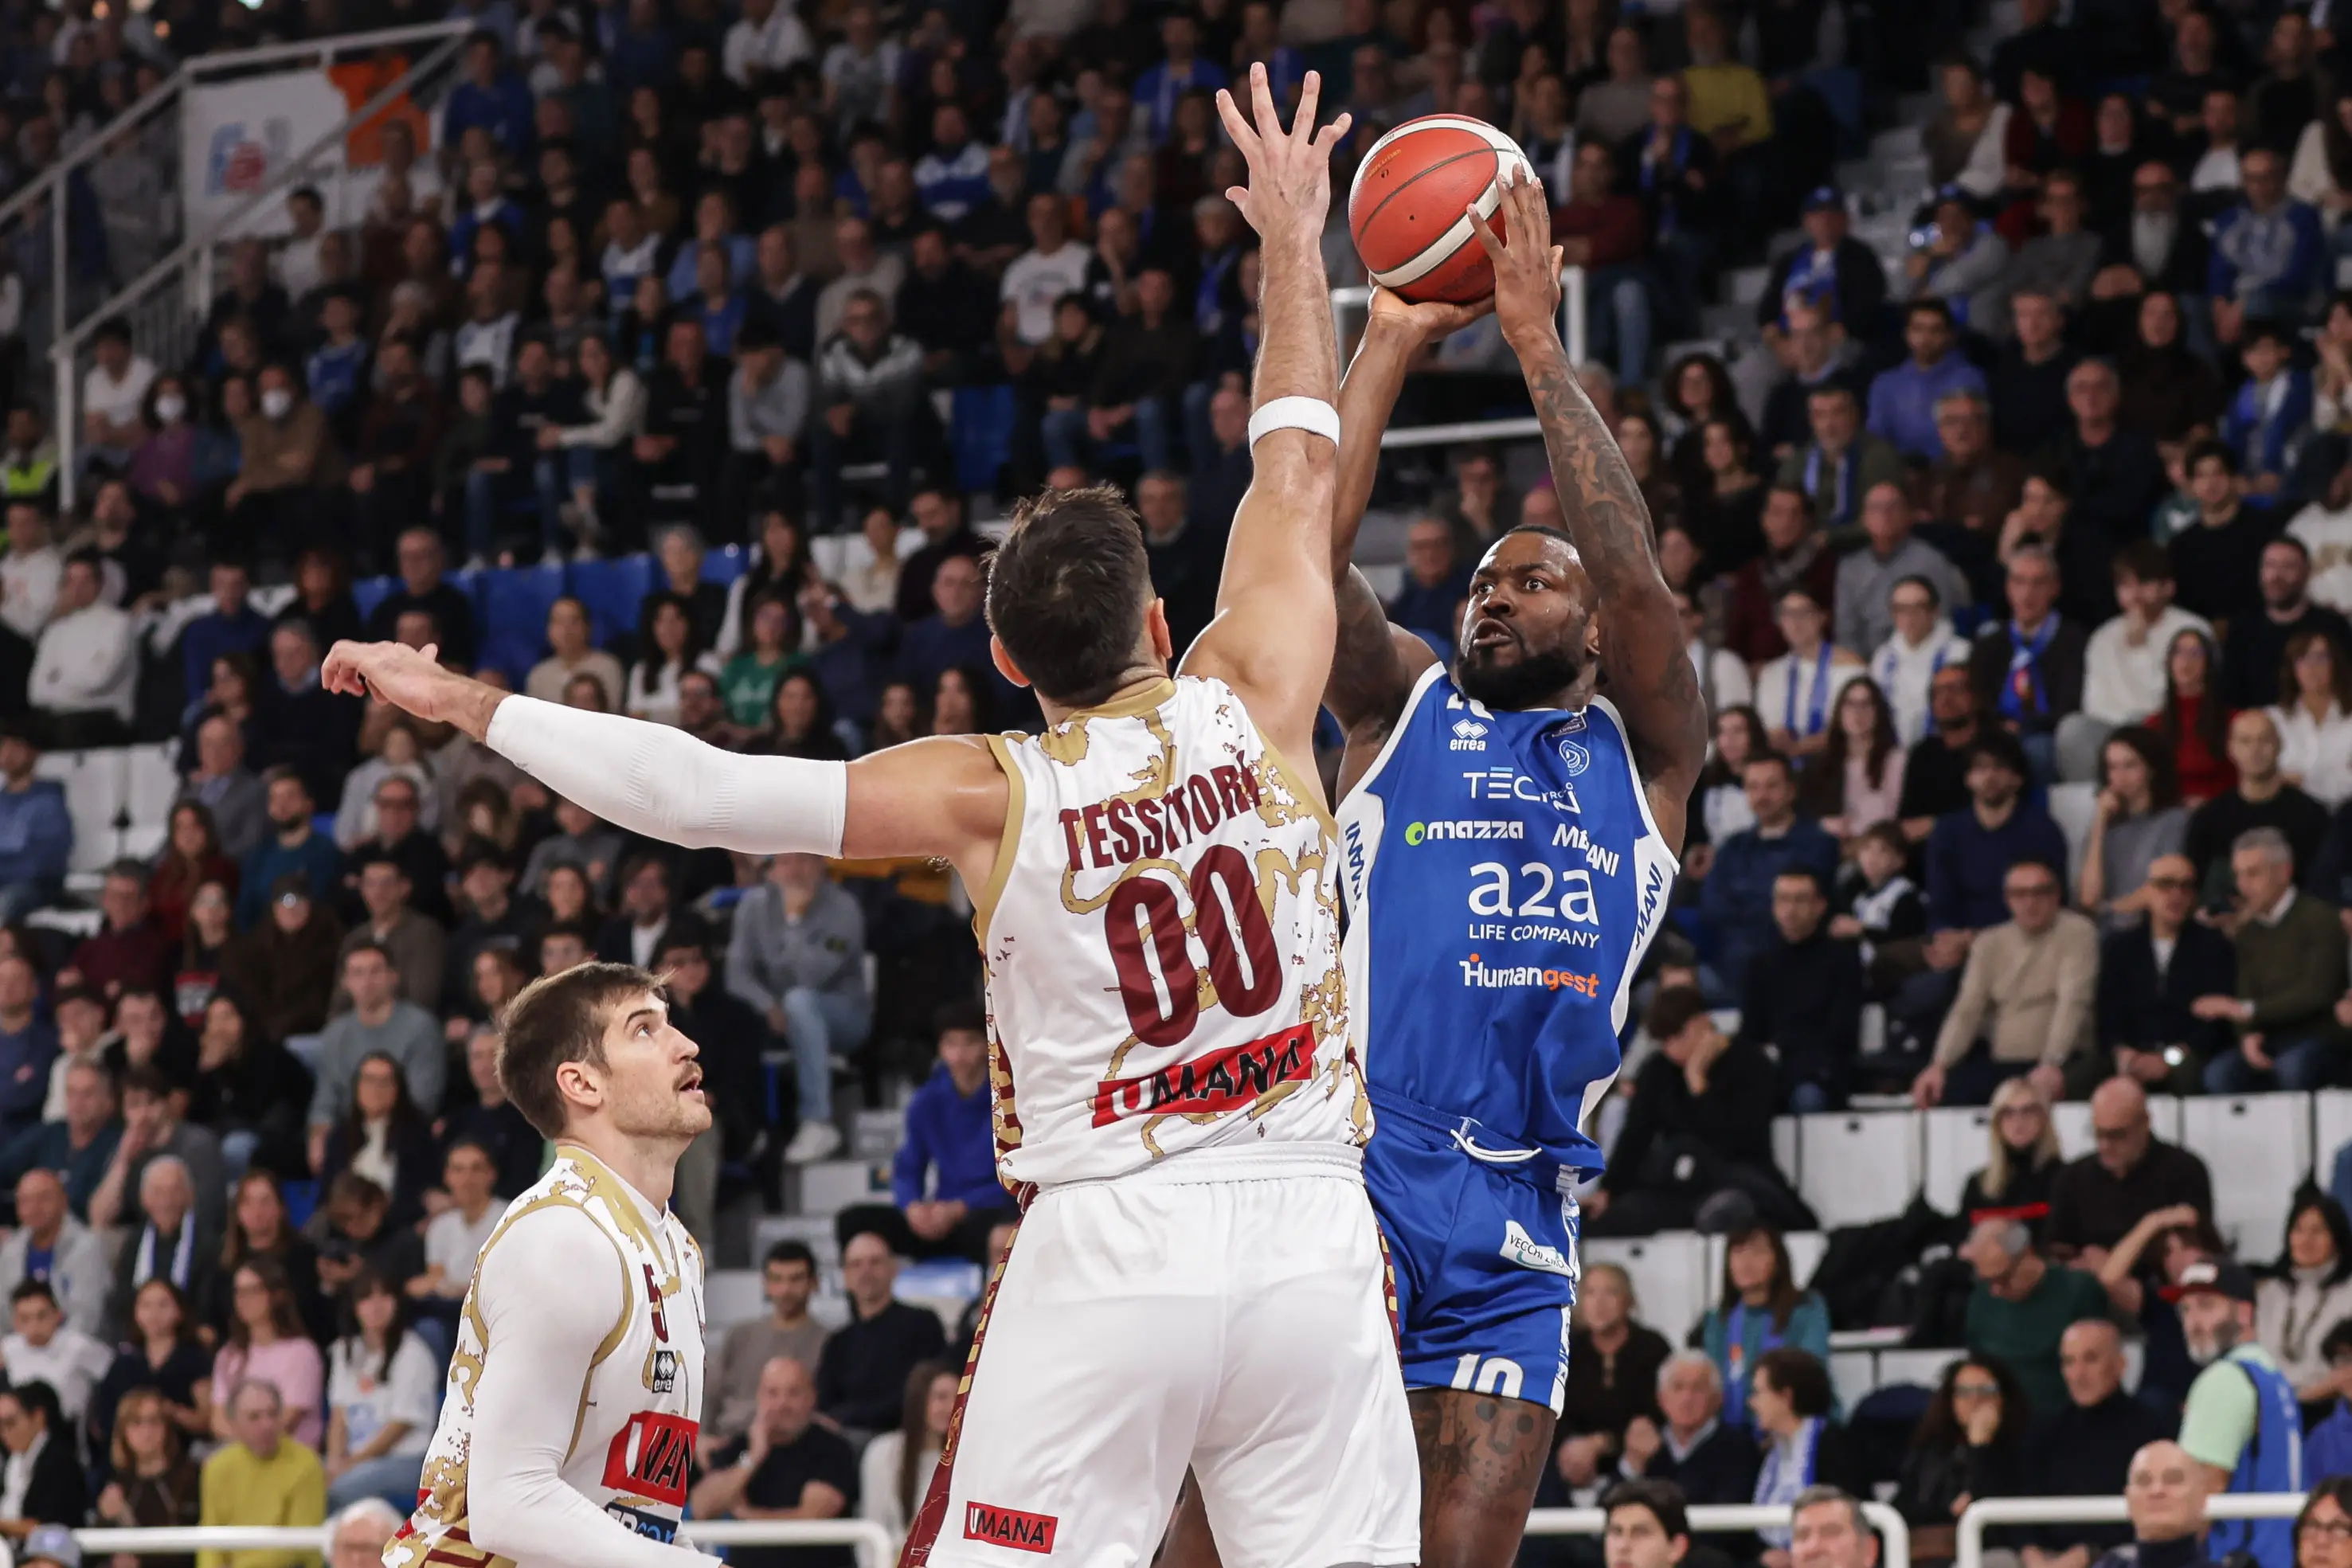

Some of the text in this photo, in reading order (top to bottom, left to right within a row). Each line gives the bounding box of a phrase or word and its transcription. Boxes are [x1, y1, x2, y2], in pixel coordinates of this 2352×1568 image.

[1450, 739, 1486, 751] errea
[1468, 862, 1599, 925] a2a
[1104, 844, 1283, 1047] 00
[1469, 924, 1600, 948] LIFE COMPANY
[1459, 953, 1599, 999] Humangest
[1111, 1038, 1300, 1117] UMANA
[969, 1507, 1046, 1547] UMANA
